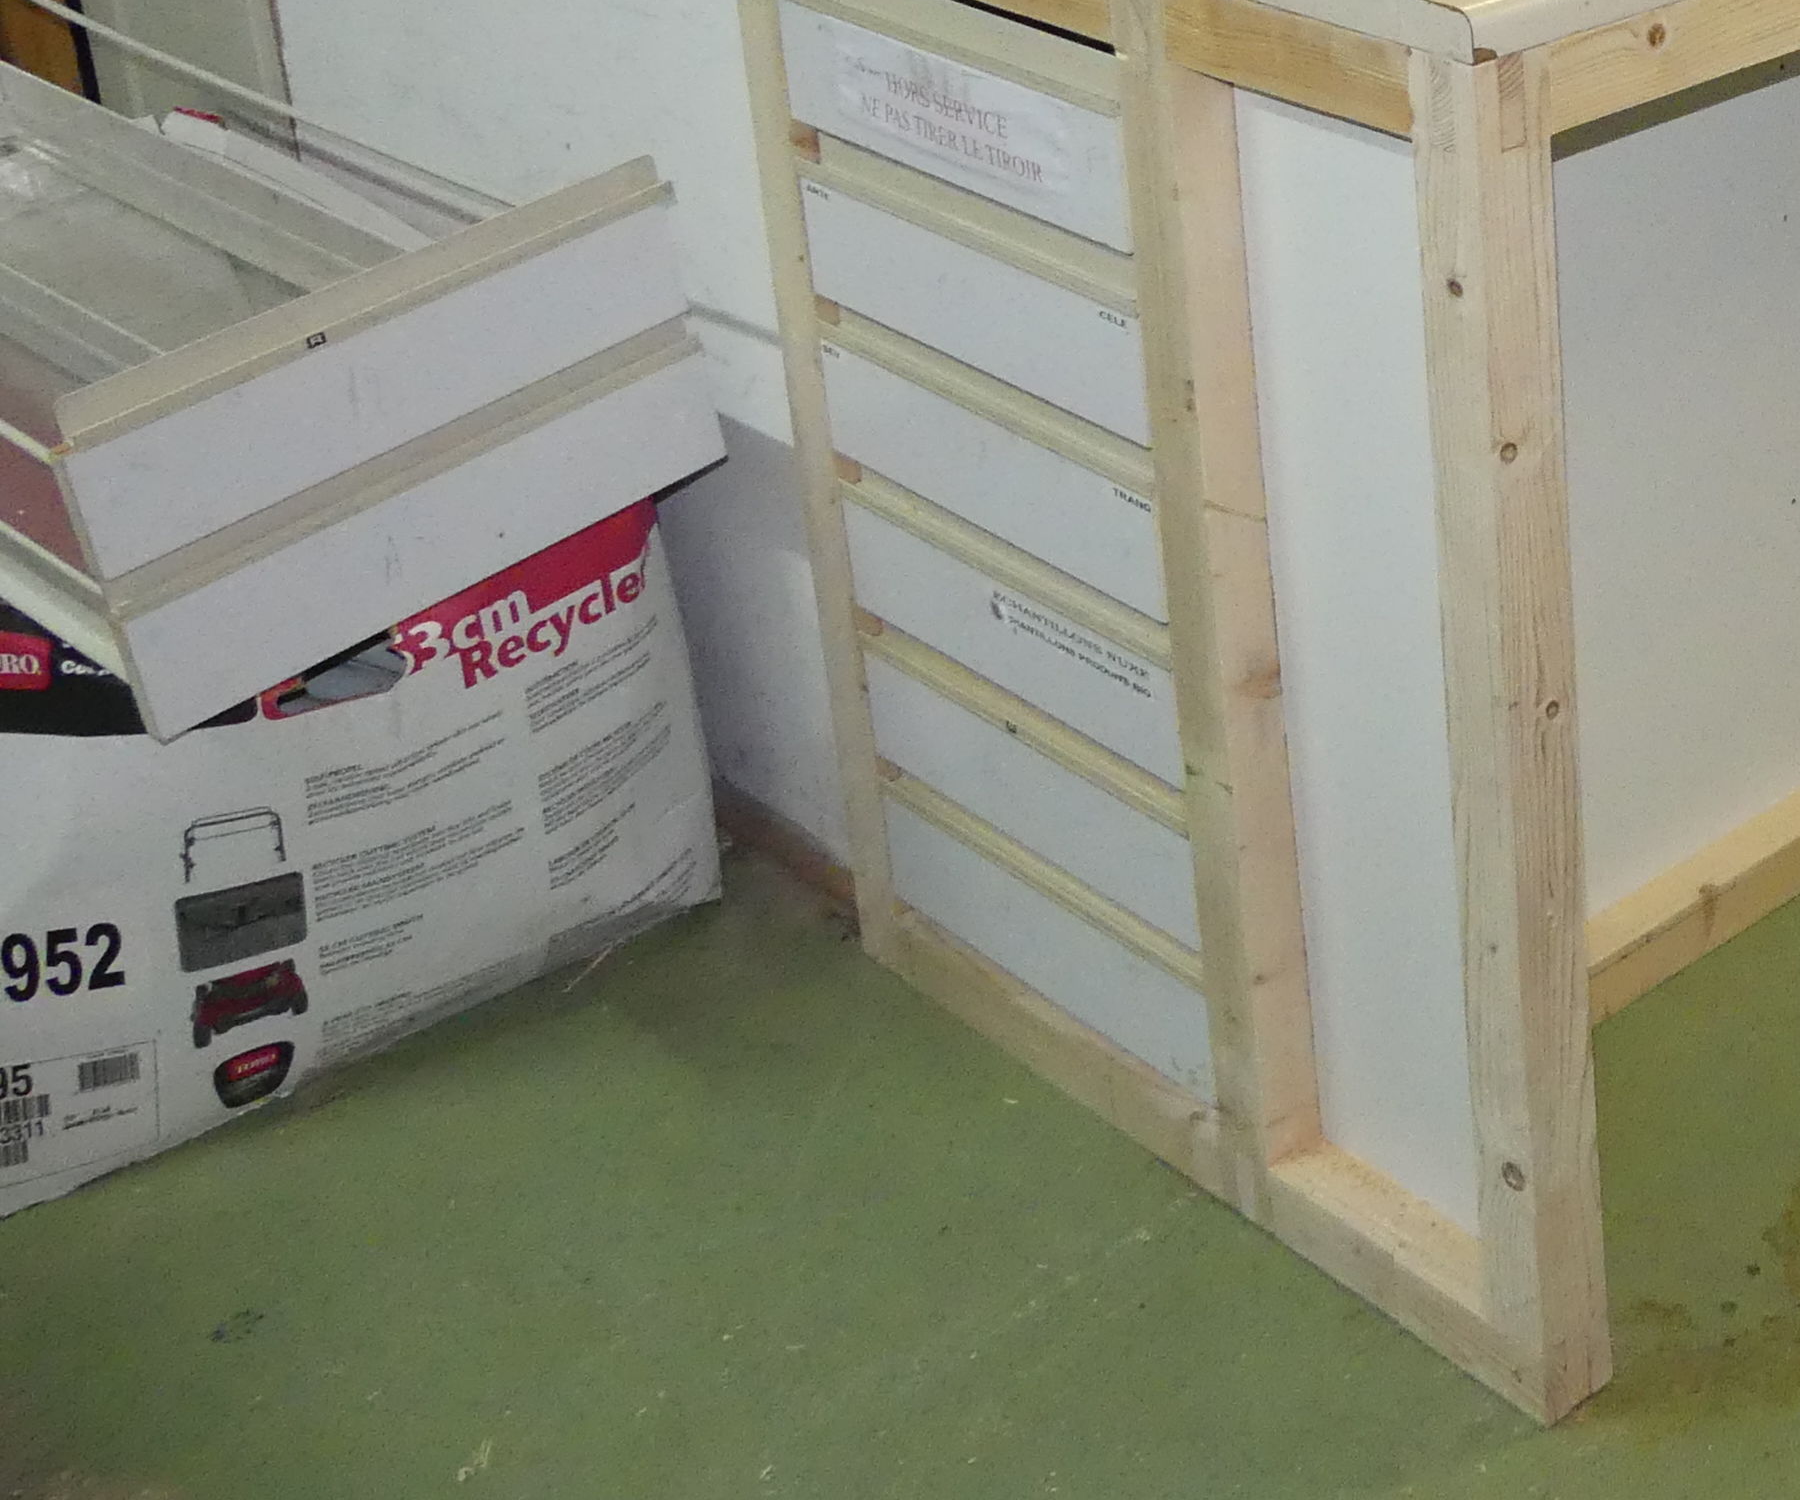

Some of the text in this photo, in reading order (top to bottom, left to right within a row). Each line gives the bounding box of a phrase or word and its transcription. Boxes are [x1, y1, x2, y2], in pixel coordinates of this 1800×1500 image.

[861, 92, 880, 118] NE
[884, 103, 911, 132] PAS
[912, 114, 957, 150] TIRER
[984, 143, 1044, 184] TIROIR
[885, 71, 1008, 140] HORS SERVICE
[1, 922, 126, 1003] 952
